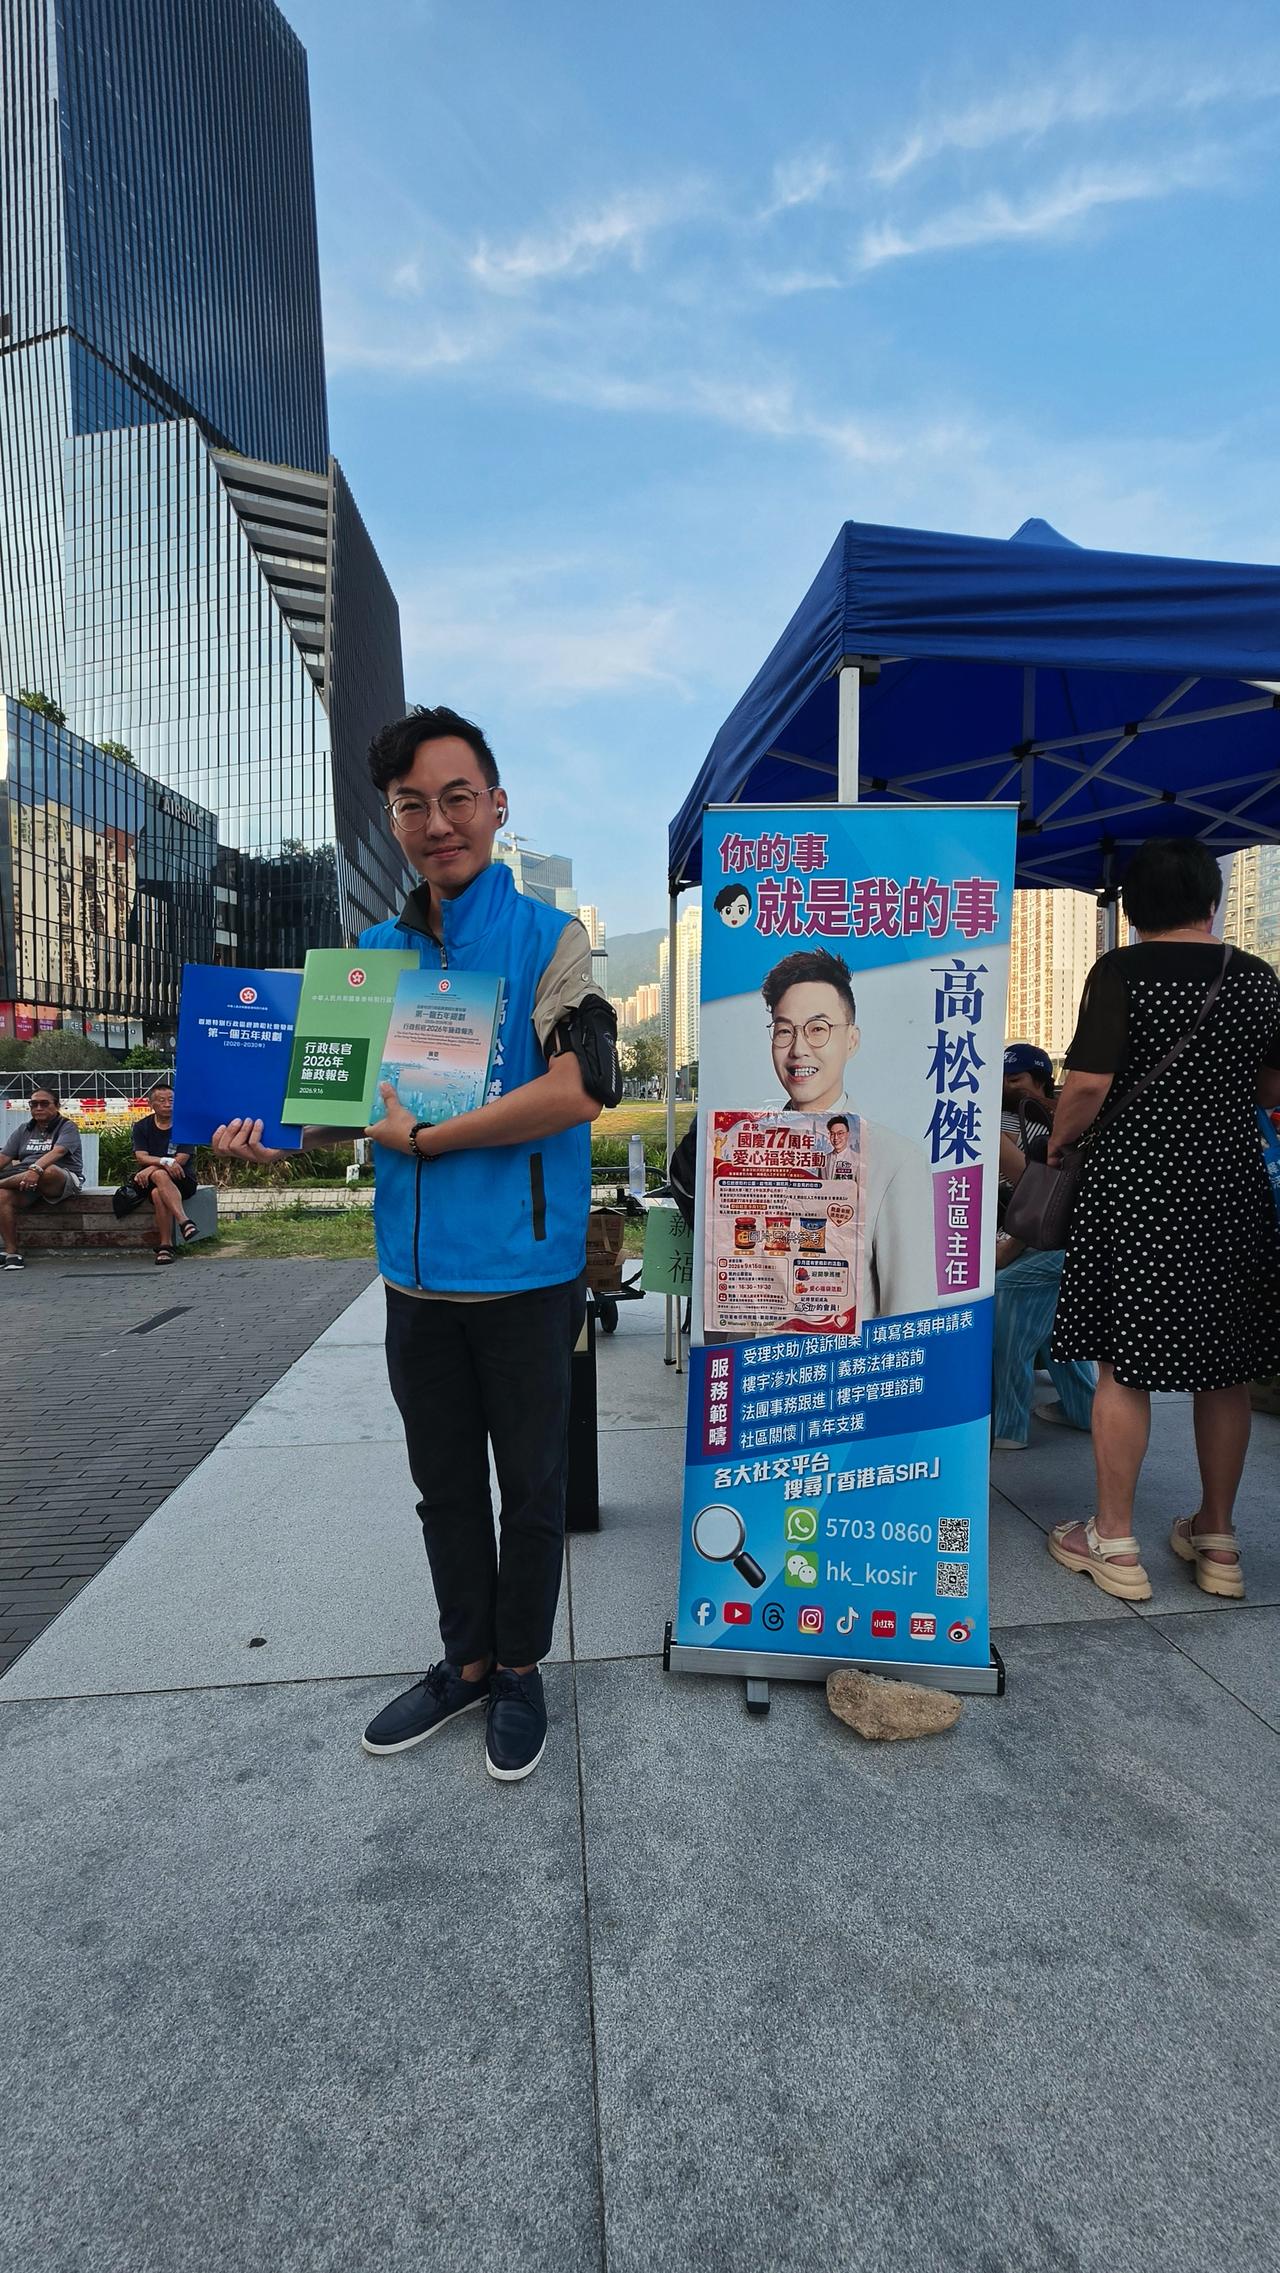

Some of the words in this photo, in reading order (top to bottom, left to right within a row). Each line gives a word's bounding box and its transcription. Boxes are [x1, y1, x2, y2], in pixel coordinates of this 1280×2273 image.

[163, 796, 204, 831] AIRSIDE
[719, 832, 828, 873] 你的事
[754, 876, 1000, 937] 就是我的事
[207, 1027, 283, 1042] 第一個五年規劃
[305, 1041, 353, 1055] 行政長官
[301, 1068, 349, 1082] 施政報告
[303, 1055, 344, 1068] 2026年
[923, 958, 989, 1165] 高松傑
[738, 1127, 815, 1150] 國慶77周年
[732, 1149, 826, 1168] 愛心福袋活動
[944, 1175, 971, 1286] 社區主任
[872, 1310, 973, 1342] 填寫各類申請表
[742, 1363, 828, 1394] 樓宇滲水服務
[837, 1348, 925, 1378] 義務法律諮詢
[708, 1357, 729, 1447] 服務範疇
[741, 1391, 827, 1422] 法團事務跟進
[836, 1376, 924, 1407] 樓宇管理諮詢
[740, 1424, 797, 1449] 社區關懷
[807, 1413, 866, 1440] 青年支援
[713, 1451, 830, 1490] 各大社交平台
[825, 1517, 876, 1540] 5703
[881, 1520, 932, 1544] 0860
[826, 1560, 918, 1587] hk_kosir
[873, 1619, 895, 1629] 小红书
[912, 1619, 935, 1633] 头条
